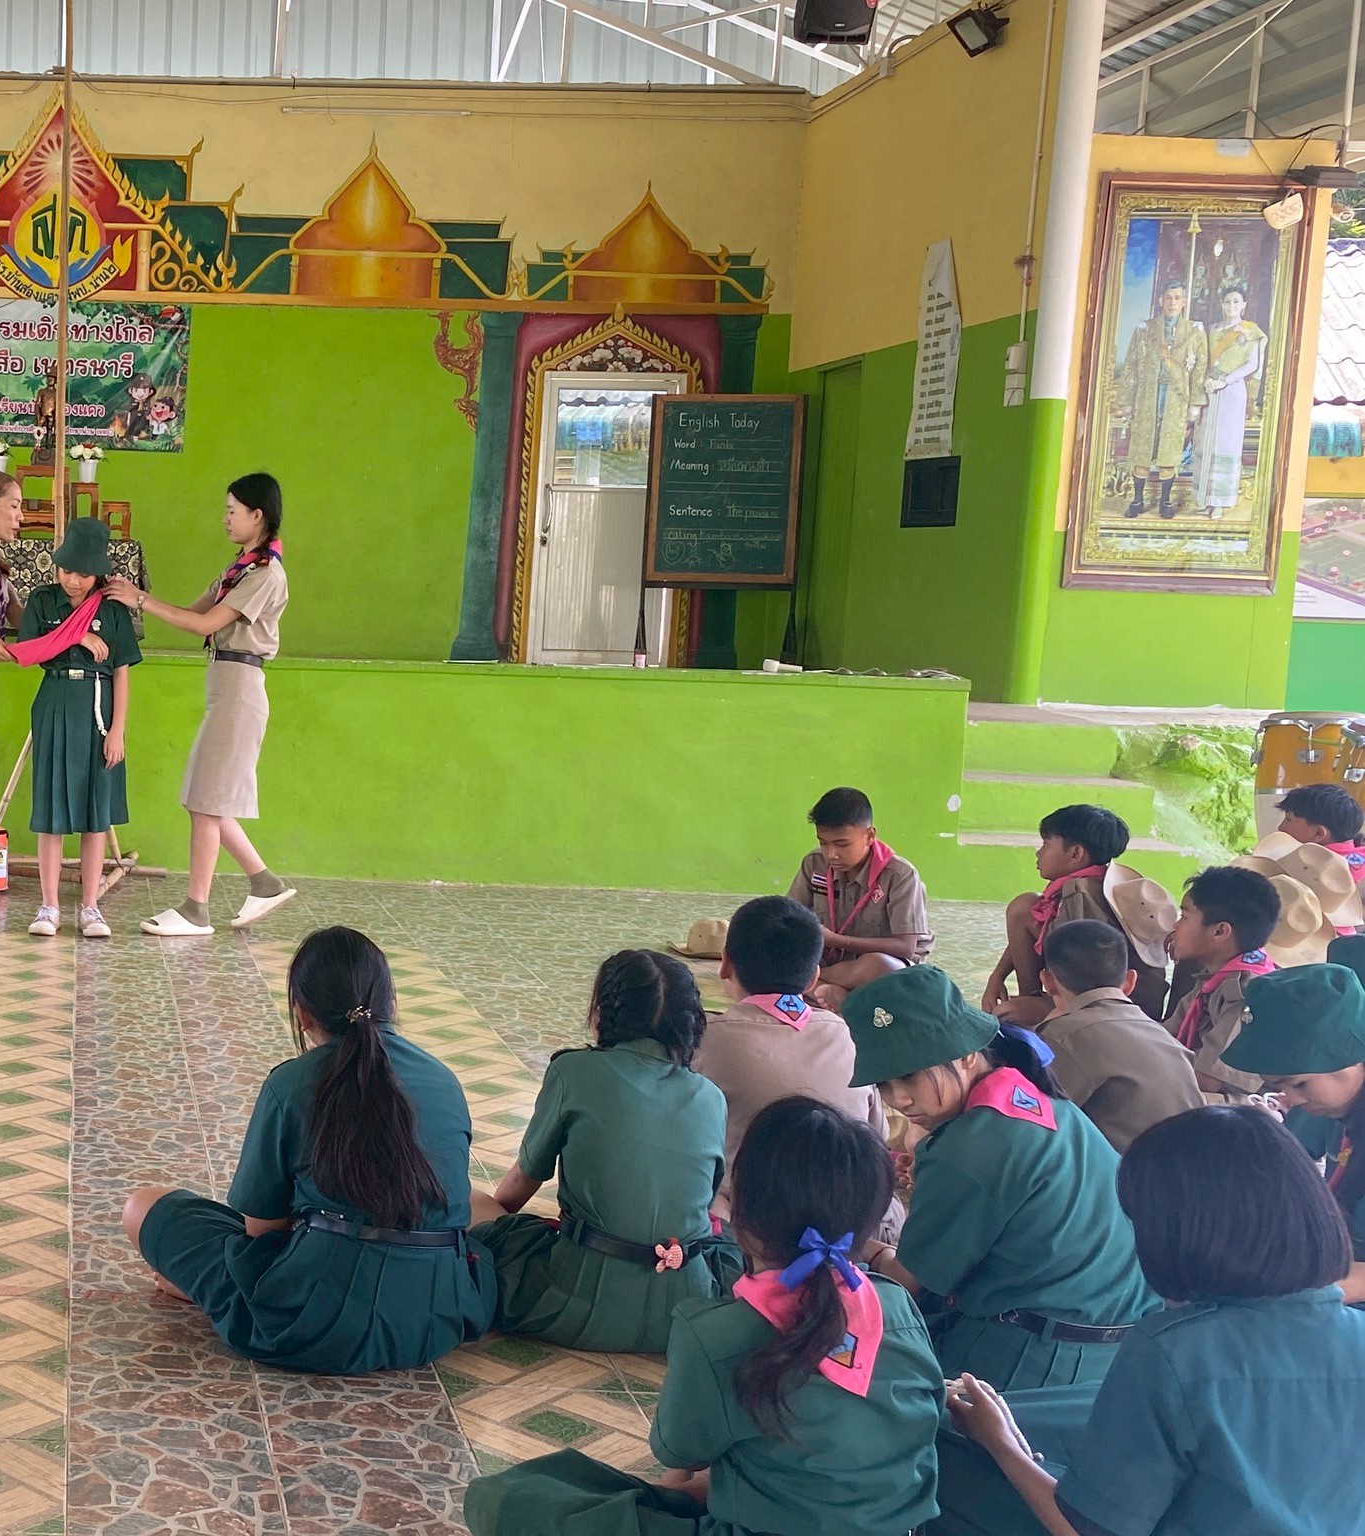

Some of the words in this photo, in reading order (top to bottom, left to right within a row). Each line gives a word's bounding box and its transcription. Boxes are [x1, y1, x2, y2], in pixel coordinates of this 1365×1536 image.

[679, 412, 720, 432] English
[729, 413, 760, 434] Today
[674, 438, 696, 449] Word
[670, 459, 710, 475] Meaning
[669, 504, 713, 517] Sentence
